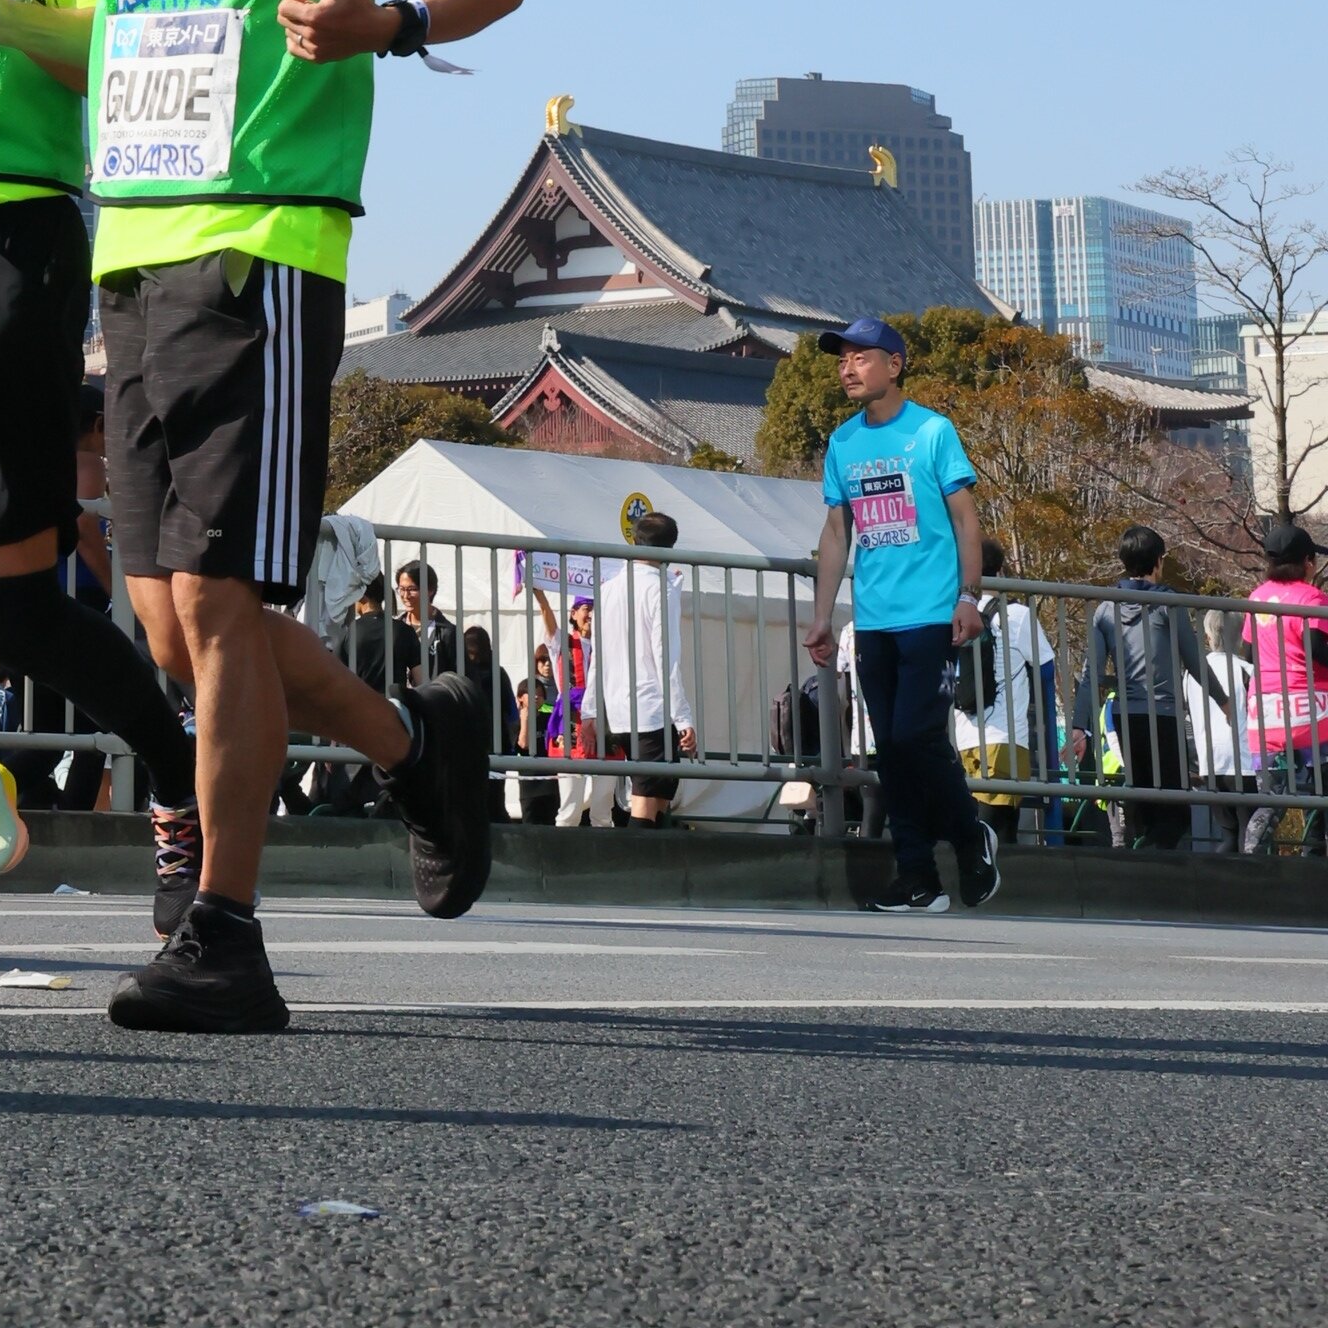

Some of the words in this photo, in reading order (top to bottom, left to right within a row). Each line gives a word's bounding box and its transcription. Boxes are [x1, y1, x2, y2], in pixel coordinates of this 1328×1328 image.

[147, 23, 220, 47] 東京メトロ
[106, 67, 214, 124] GUIDE
[137, 129, 182, 140] MARATHON
[183, 129, 208, 139] 2025
[863, 478, 903, 493] 東京メトロ
[862, 497, 904, 525] 44107
[543, 566, 584, 585] TOYO
